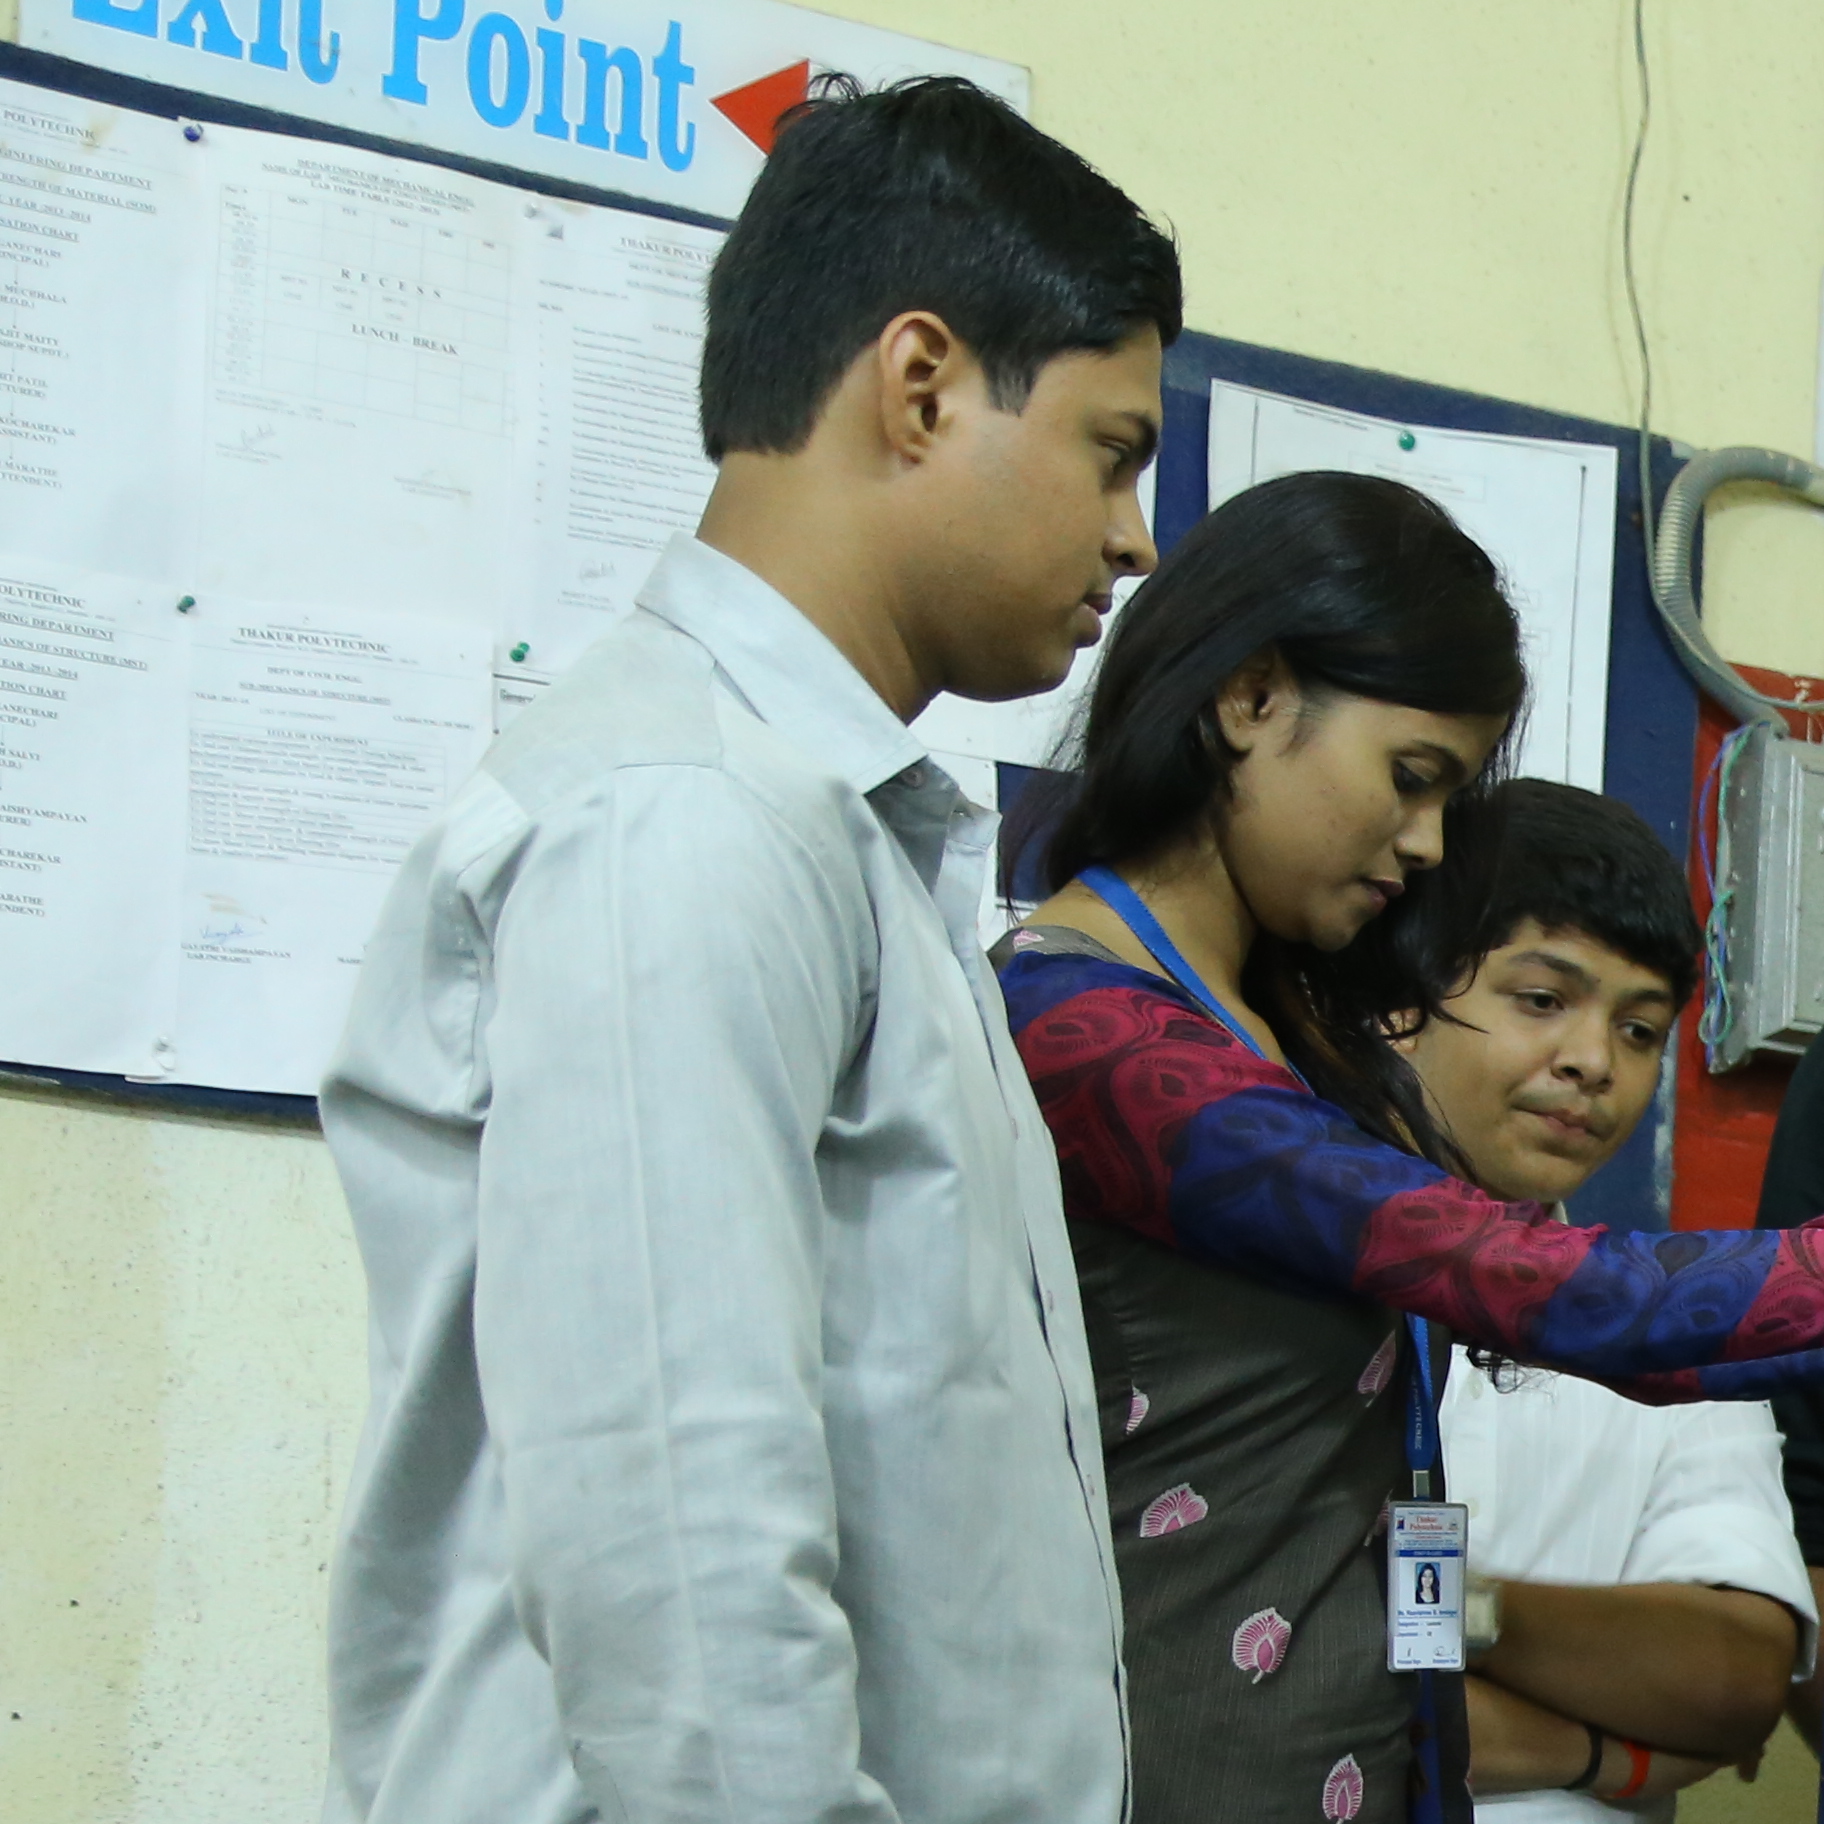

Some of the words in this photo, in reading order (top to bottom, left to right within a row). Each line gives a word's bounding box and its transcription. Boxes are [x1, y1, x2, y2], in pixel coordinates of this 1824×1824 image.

[72, 0, 341, 85] xit
[381, 0, 695, 172] Point
[0, 217, 39, 232] SATION
[351, 322, 400, 343] LUNCH
[411, 335, 460, 357] BREAK
[31, 617, 115, 640] DEPARTMENT
[238, 626, 296, 643] THAKUR
[297, 632, 391, 654] POLYTECHNIC
[0, 657, 24, 669] EAR
[28, 685, 67, 699] CHART
[0, 702, 58, 719] ANECHARI
